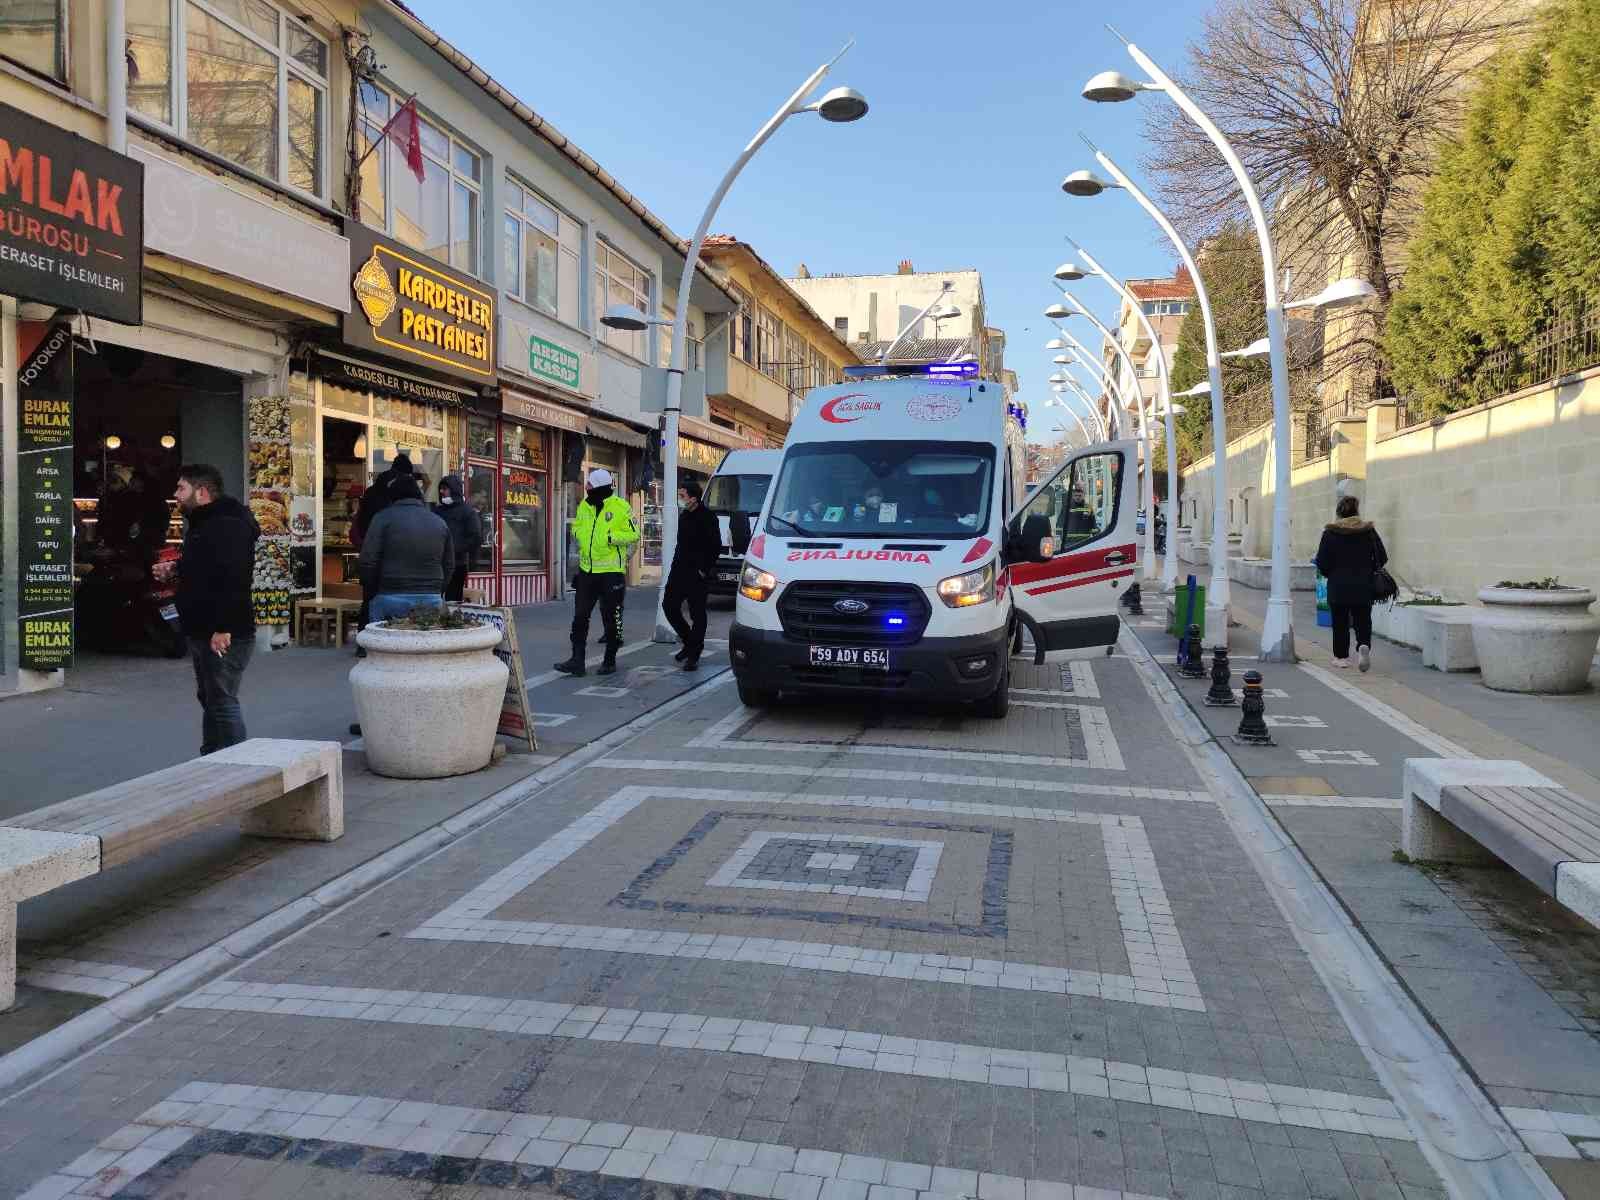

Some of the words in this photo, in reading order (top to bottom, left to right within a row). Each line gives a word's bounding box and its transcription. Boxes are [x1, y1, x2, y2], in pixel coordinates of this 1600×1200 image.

[60, 259, 125, 293] İŞLEMLERİ
[399, 267, 490, 331] KARDEŞLER
[402, 307, 487, 361] PASTANESİ
[24, 399, 70, 413] BURAK
[24, 413, 70, 427] EMLAK
[36, 467, 60, 476] ARSA
[34, 492, 62, 500] TARLA
[35, 516, 61, 525] DAİRE
[37, 541, 59, 549] TAPU
[29, 564, 67, 572] VERASET
[25, 622, 70, 633] BURAK
[25, 635, 70, 647] EMLAK
[817, 648, 832, 661] 59
[863, 650, 886, 663] 654
